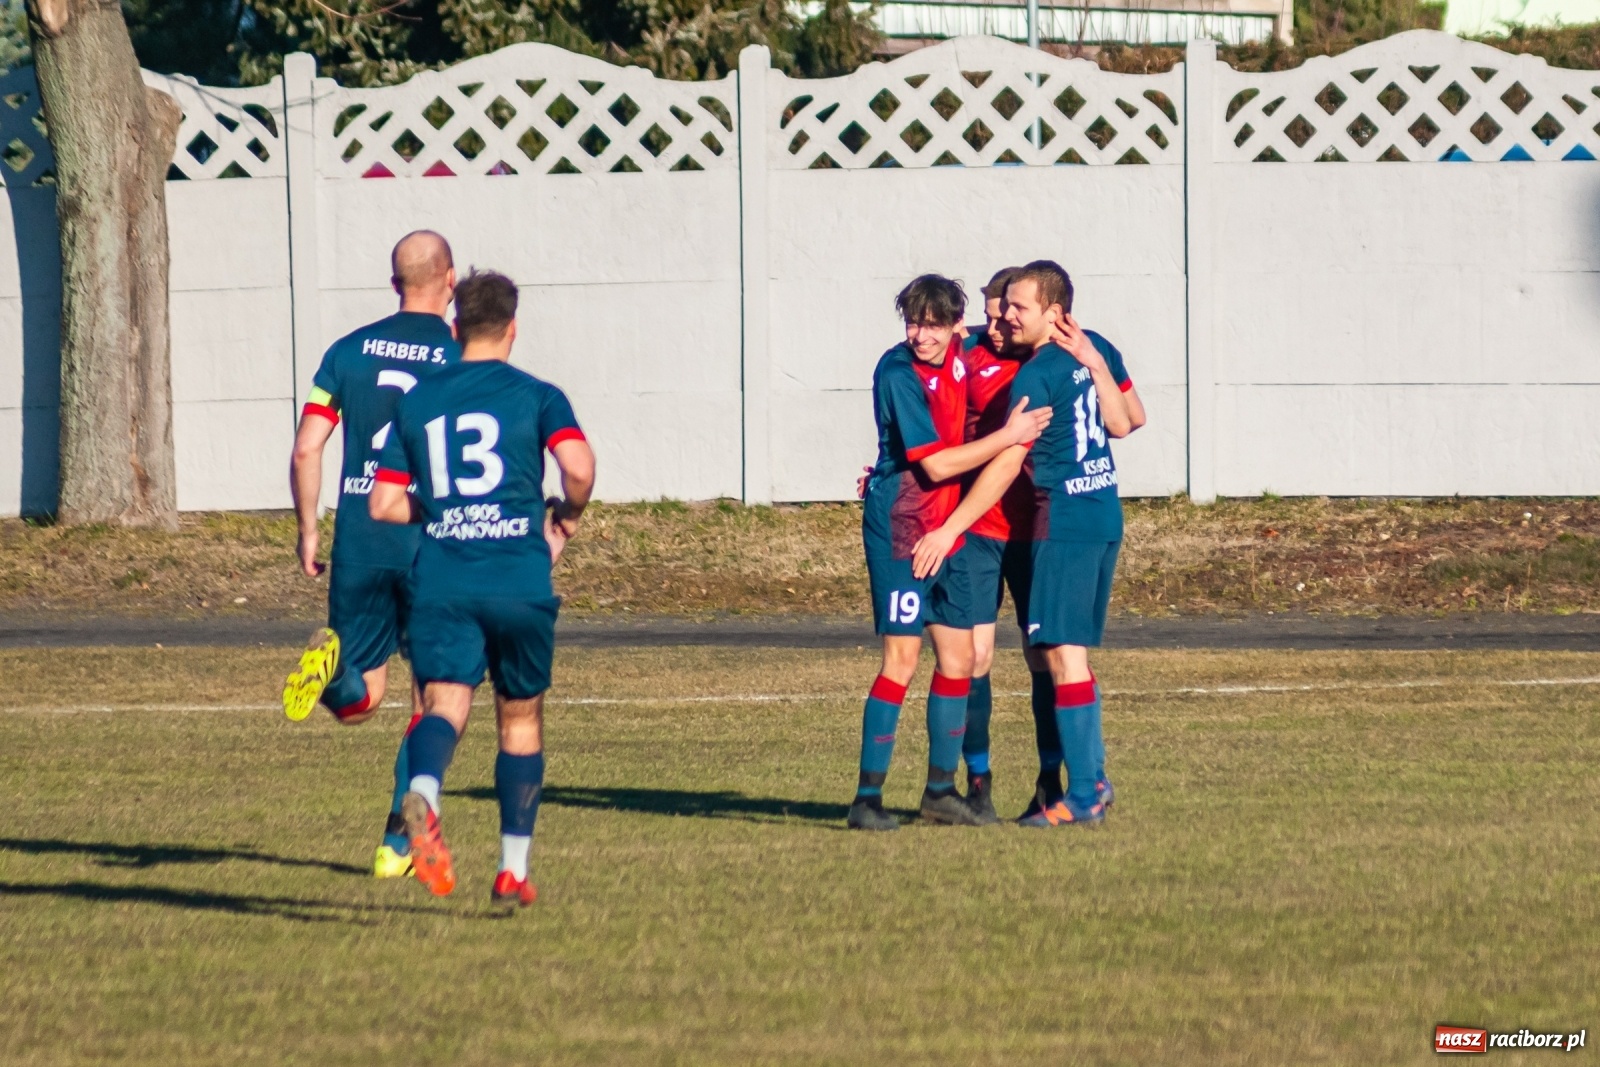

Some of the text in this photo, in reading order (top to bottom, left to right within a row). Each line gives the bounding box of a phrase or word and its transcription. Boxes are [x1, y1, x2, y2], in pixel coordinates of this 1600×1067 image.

[363, 339, 447, 365] HERBER S.
[424, 412, 504, 499] 13
[442, 506, 464, 526] KS
[889, 590, 921, 624] 19
